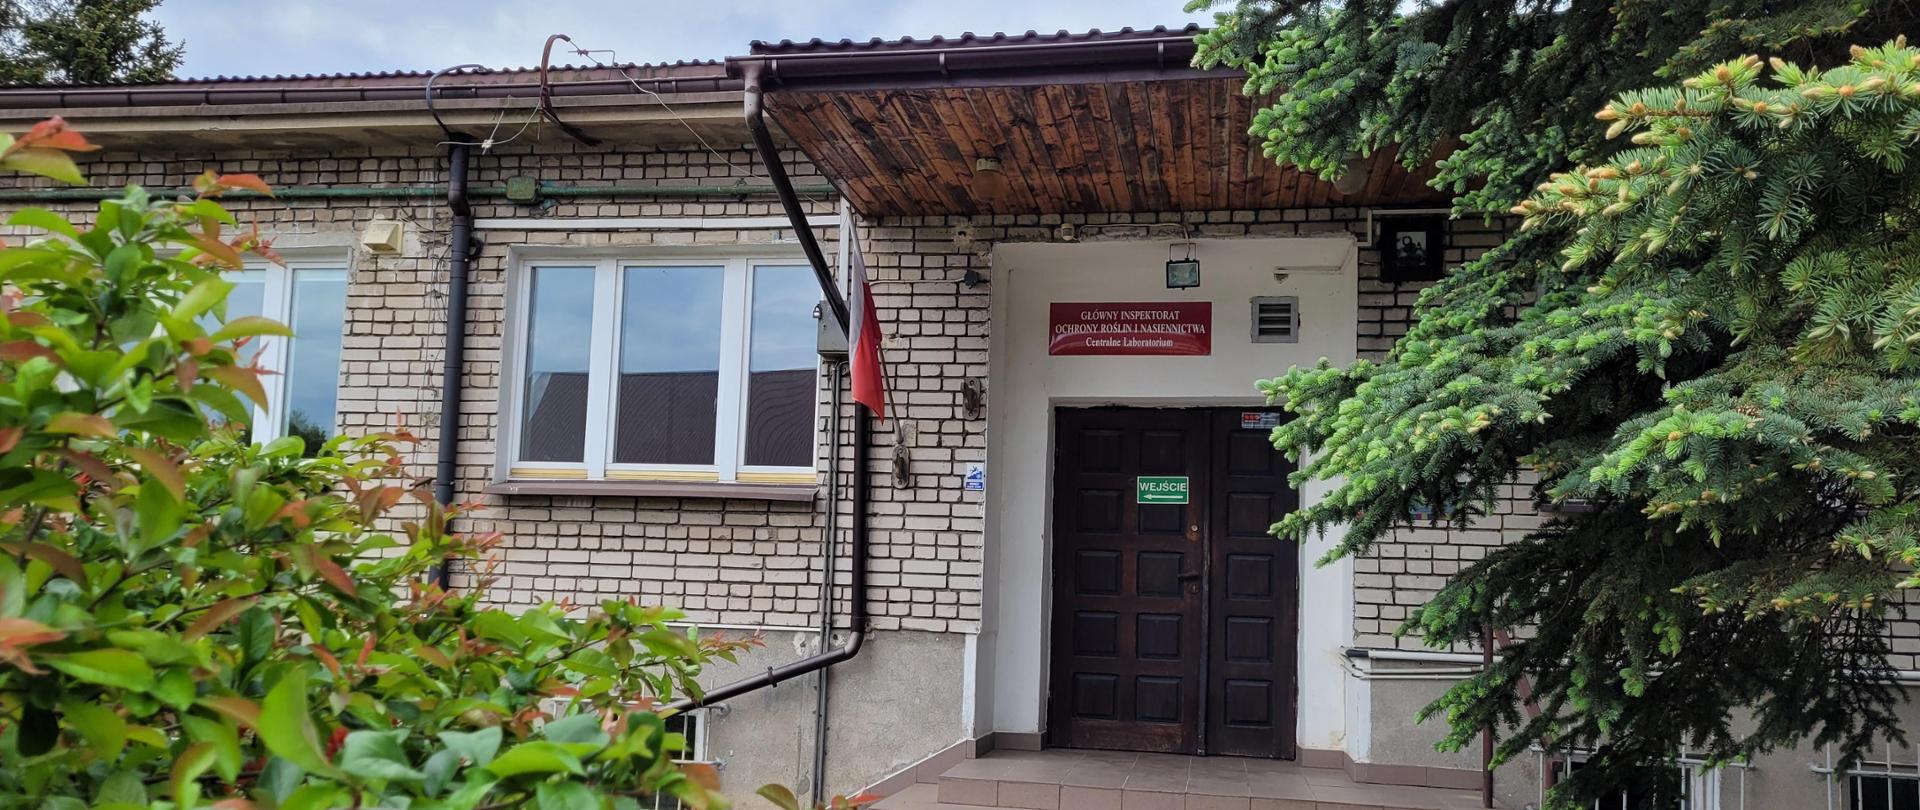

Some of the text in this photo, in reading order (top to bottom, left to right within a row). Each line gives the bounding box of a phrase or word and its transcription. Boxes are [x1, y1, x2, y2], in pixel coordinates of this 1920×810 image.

[1080, 309, 1180, 321] GŁÓWNY INSPEKTORAT
[1055, 321, 1206, 334] OCHRONY ROŚLIN I NASIENNICTWA
[1086, 337, 1174, 347] Centralne Laboratorium
[1139, 480, 1187, 492] WEJŚCIE
